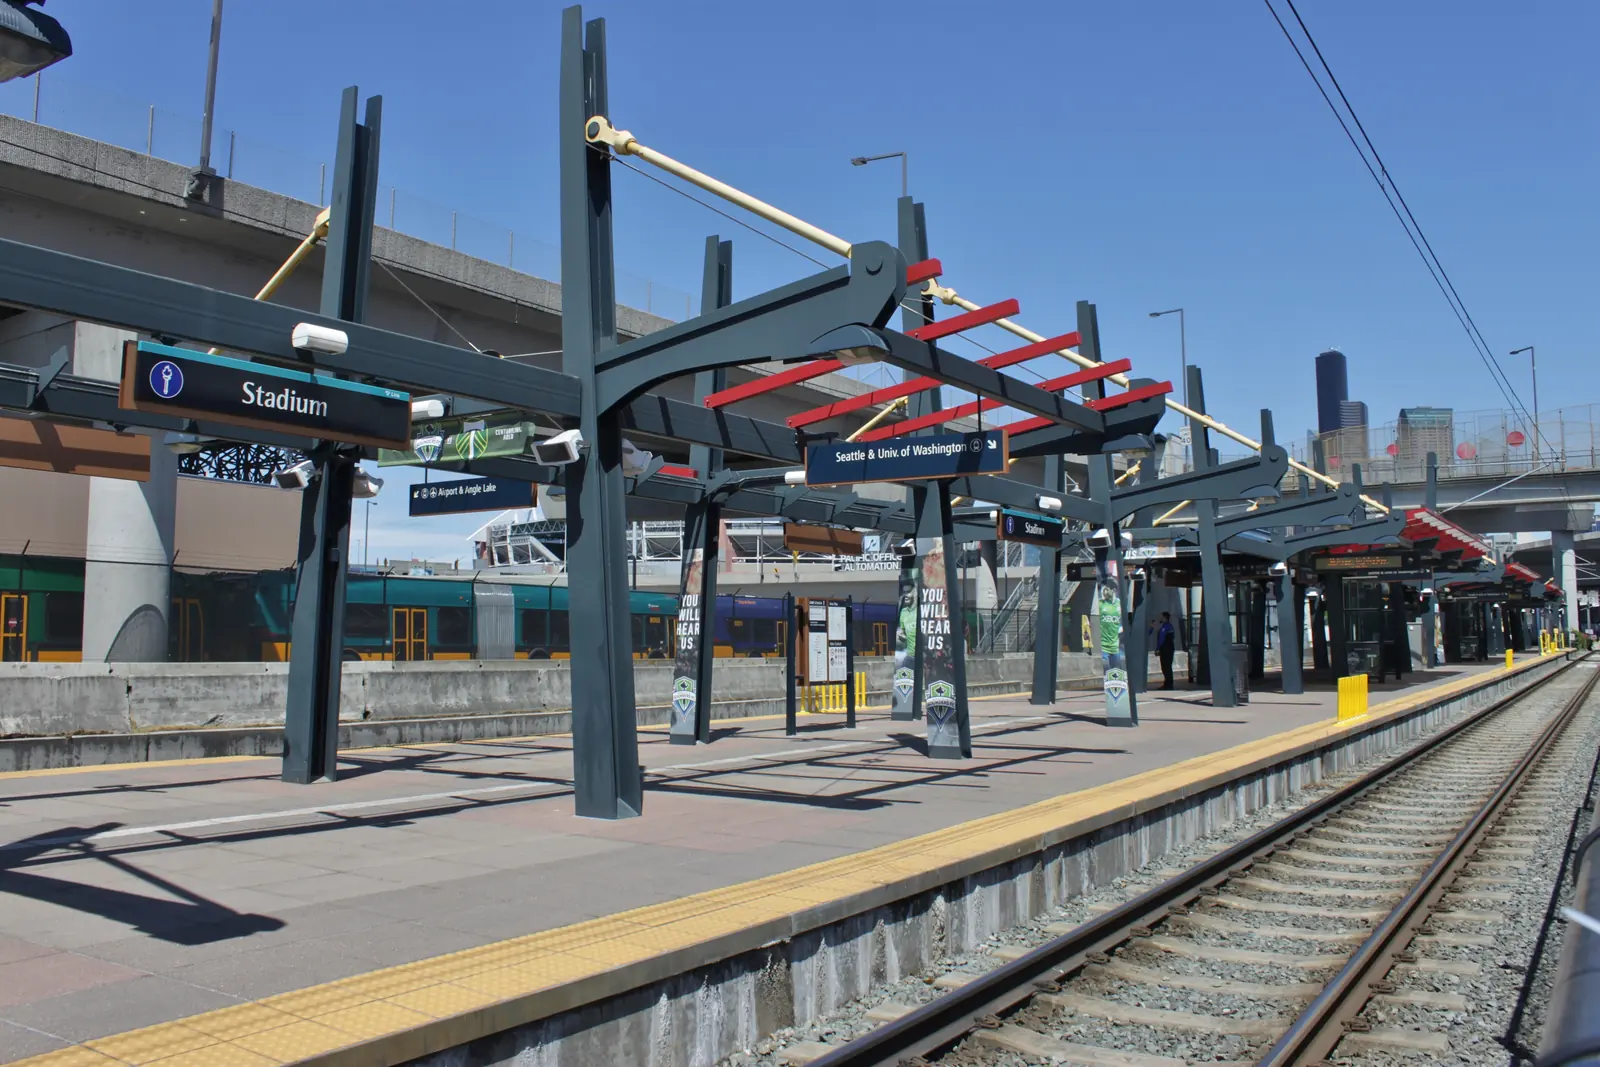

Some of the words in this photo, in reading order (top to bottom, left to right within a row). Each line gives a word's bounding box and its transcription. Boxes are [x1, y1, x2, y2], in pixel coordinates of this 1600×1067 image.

[241, 380, 328, 417] Stadium
[835, 450, 866, 462] Seattle
[867, 449, 876, 460] &
[877, 447, 900, 459] Univ.
[900, 445, 911, 457] of
[912, 443, 967, 456] Washington
[438, 487, 458, 498] Airport
[458, 485, 464, 495] &
[465, 484, 482, 496] Angle
[482, 483, 497, 493] Lake
[840, 554, 871, 562] PACIFIC
[1125, 550, 1137, 560] US
[844, 562, 899, 570] AUTOMATION
[682, 594, 699, 607] YOU
[922, 588, 943, 602] YOU
[679, 608, 700, 621] WILL
[920, 604, 948, 618] WILL
[677, 622, 700, 636] HEAR
[920, 620, 951, 634] HEAR
[681, 637, 693, 649] US
[927, 636, 944, 650] US
